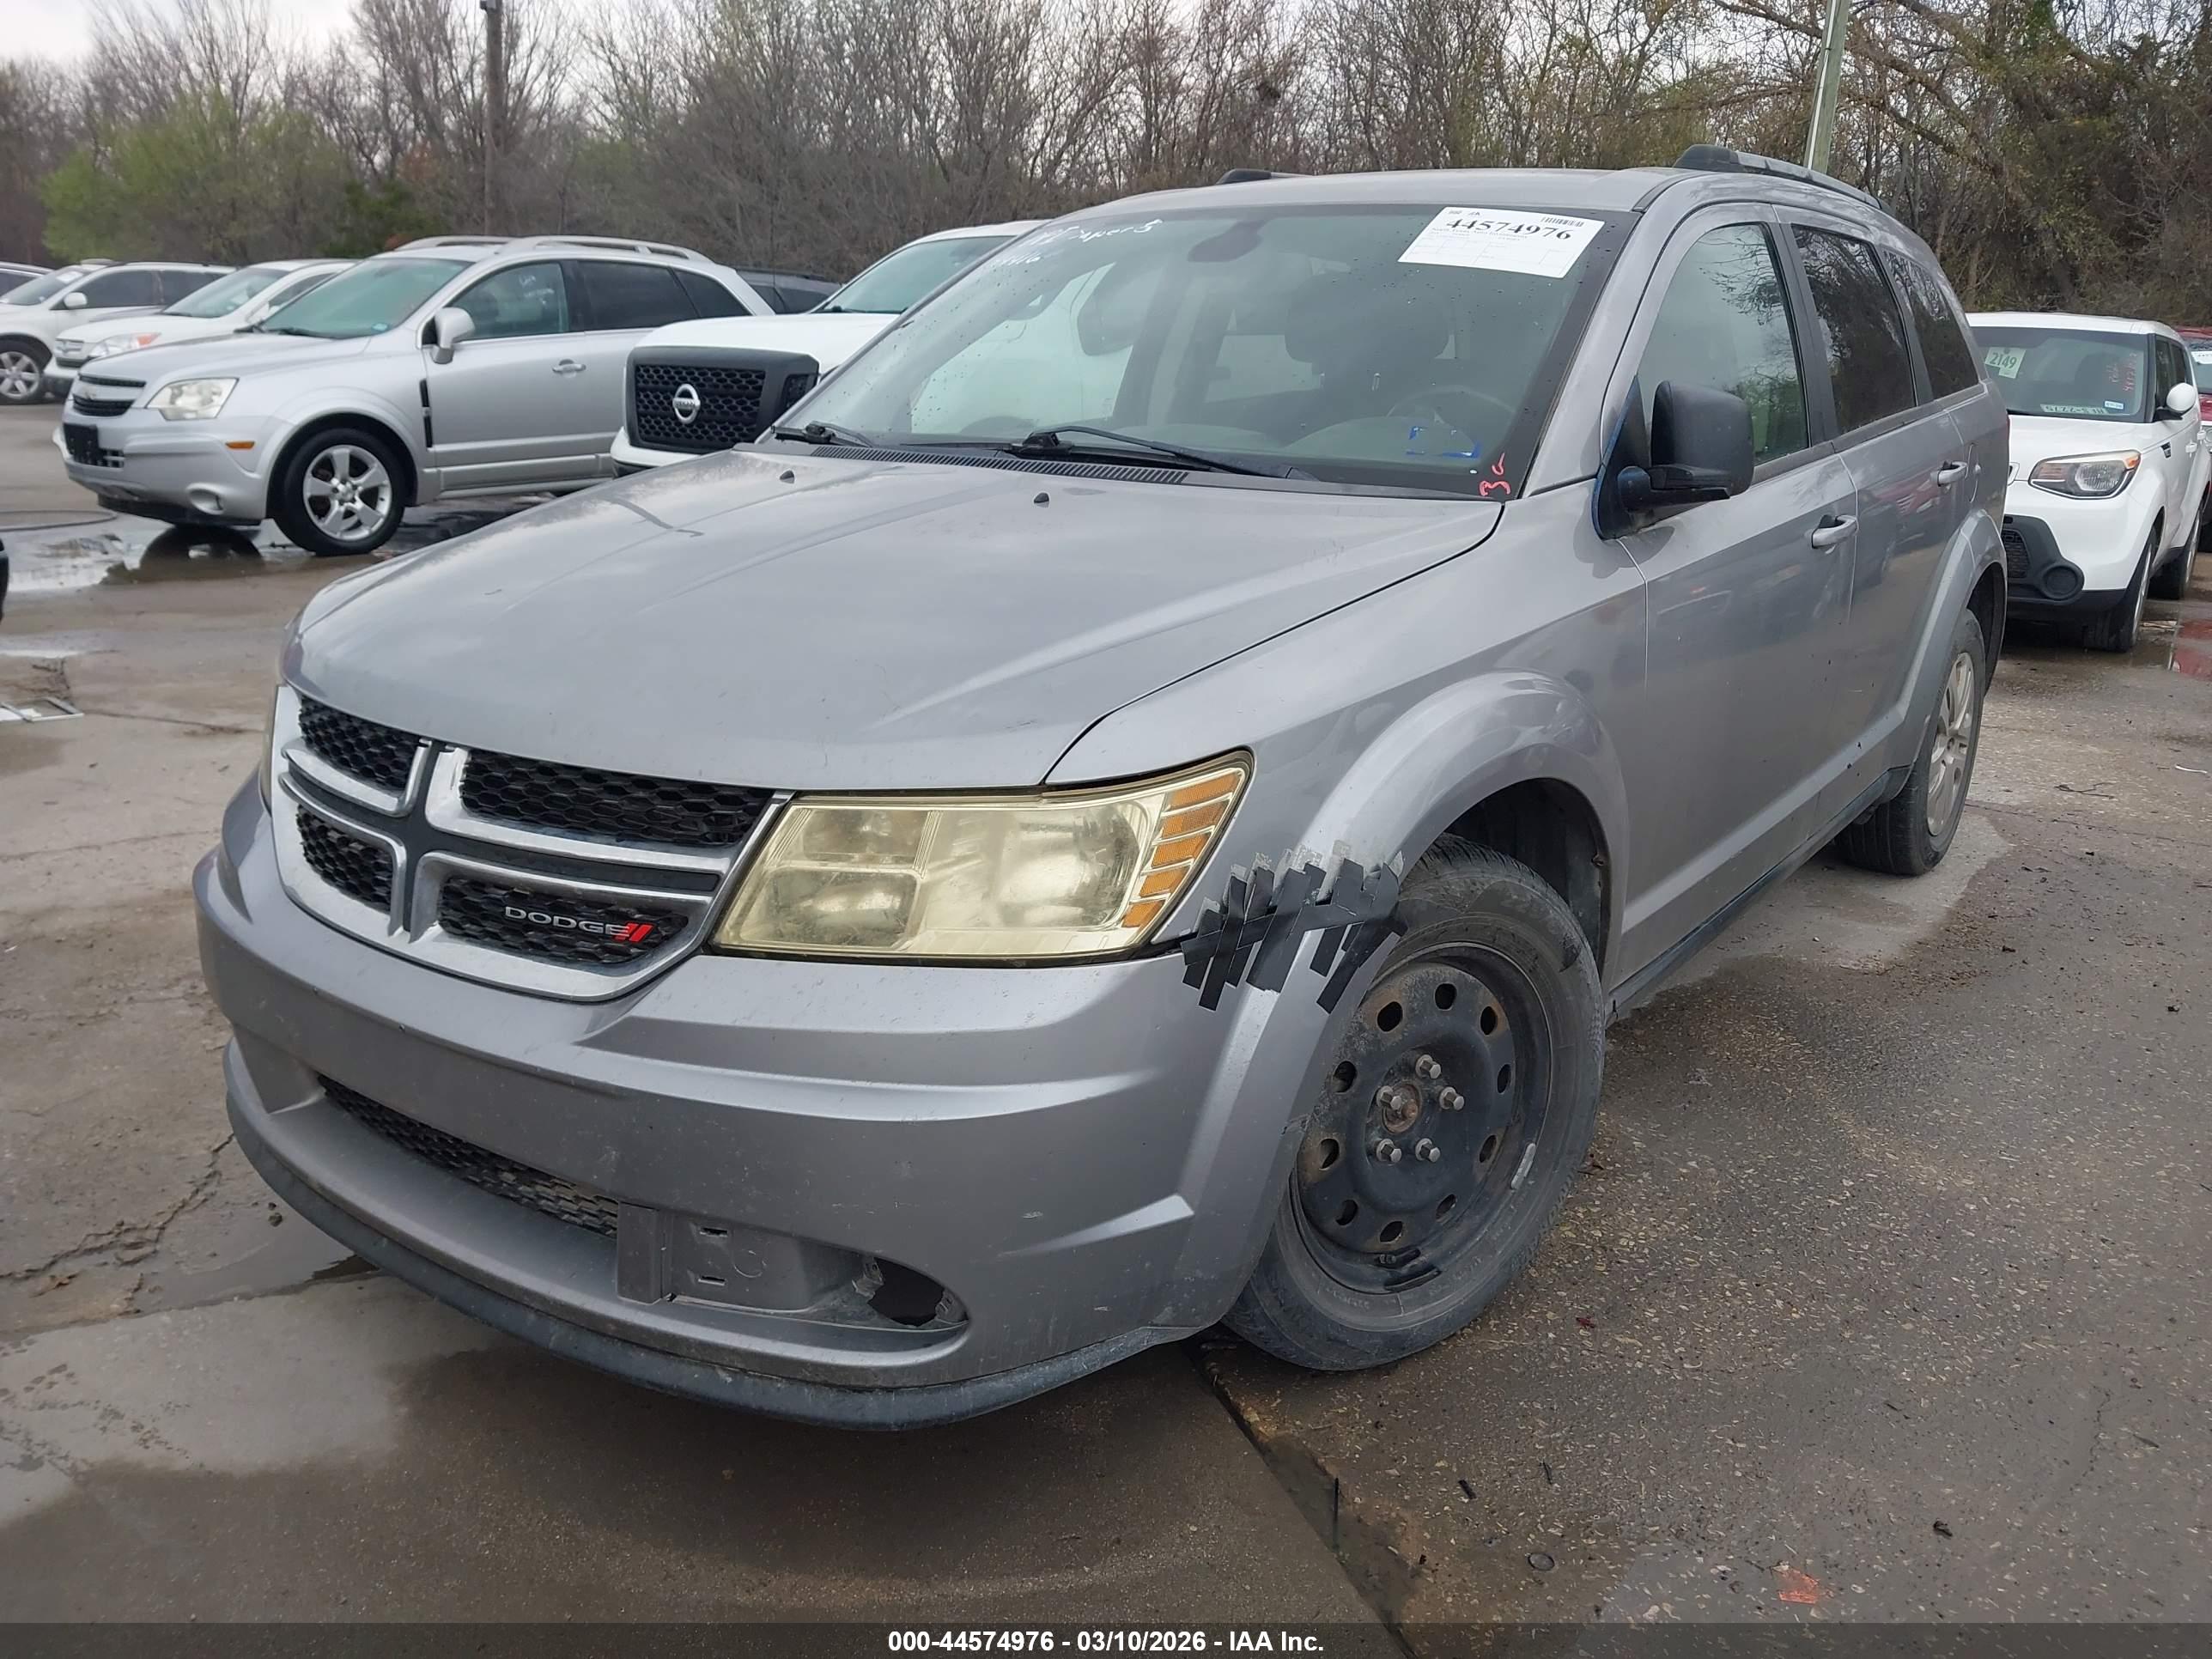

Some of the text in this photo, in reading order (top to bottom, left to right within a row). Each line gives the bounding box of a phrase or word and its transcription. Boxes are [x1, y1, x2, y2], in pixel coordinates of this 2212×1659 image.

[1446, 218, 1574, 240] 44574976
[1990, 351, 2018, 369] 2149
[505, 905, 630, 938] DODGE
